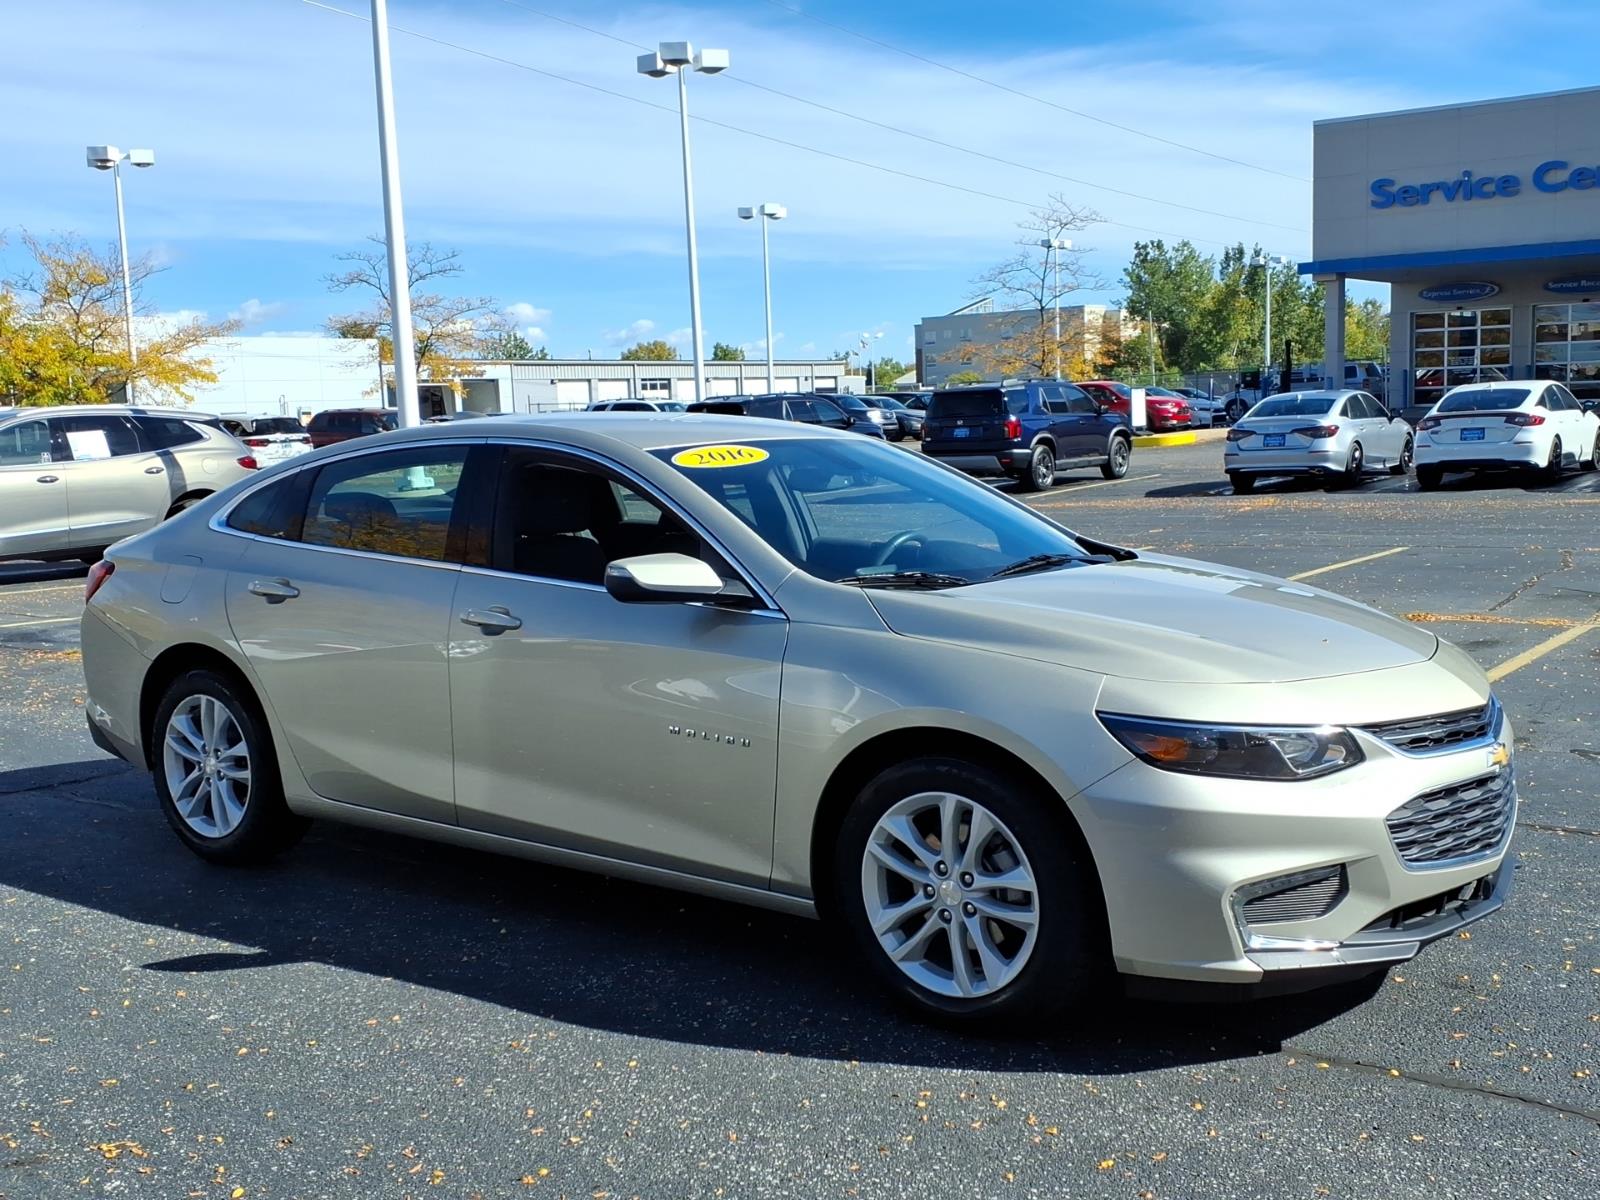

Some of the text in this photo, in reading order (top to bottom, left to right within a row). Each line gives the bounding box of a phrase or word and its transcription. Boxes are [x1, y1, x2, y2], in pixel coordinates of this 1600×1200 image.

[1370, 160, 1600, 209] Service Ce
[689, 448, 755, 465] 2016
[668, 725, 751, 748] MALIBU
